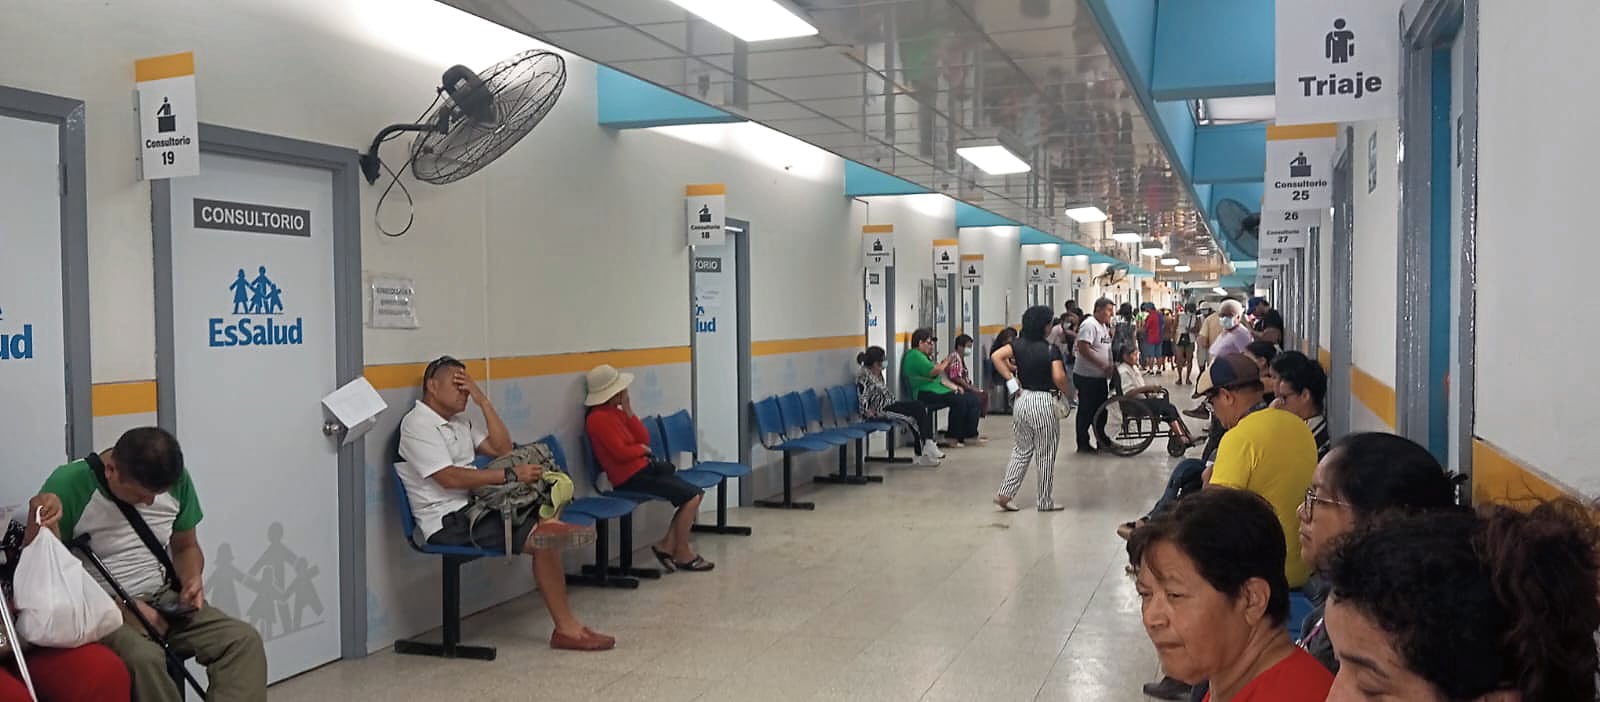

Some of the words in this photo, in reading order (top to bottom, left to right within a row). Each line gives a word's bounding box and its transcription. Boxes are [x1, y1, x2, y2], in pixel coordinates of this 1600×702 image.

[1298, 71, 1382, 99] Triaje
[145, 136, 191, 149] Consultorio
[161, 151, 175, 165] 19
[1274, 179, 1328, 189] Consultorio
[1292, 190, 1310, 201] 25
[201, 206, 304, 231] CONSULTORIO
[1284, 211, 1299, 221] 26
[1278, 235, 1289, 243] 27
[208, 317, 303, 347] EsSalud
